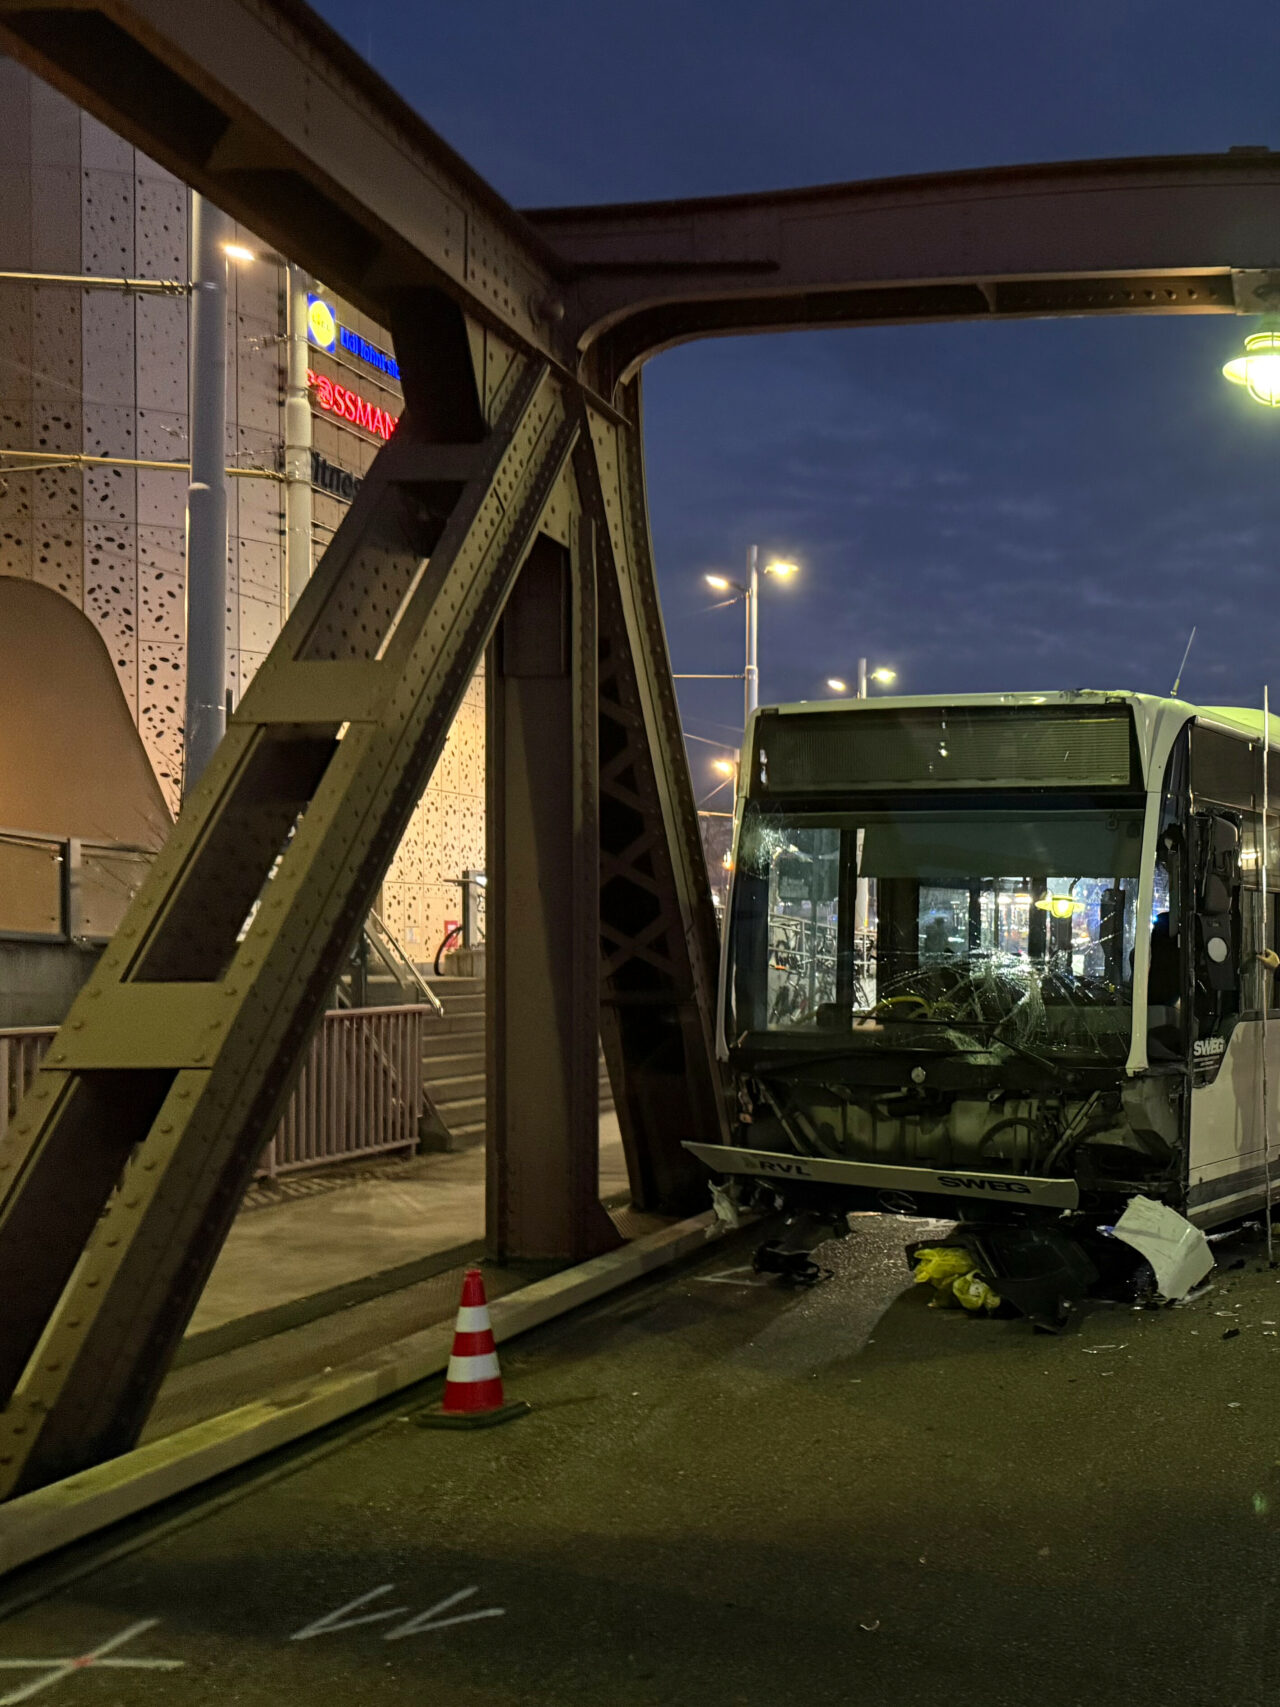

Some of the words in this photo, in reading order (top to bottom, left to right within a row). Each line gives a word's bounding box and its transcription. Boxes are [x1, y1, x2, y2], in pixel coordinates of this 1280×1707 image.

[339, 326, 359, 355] Lidl
[1193, 1038, 1225, 1056] SWEG
[759, 1160, 813, 1176] RVL
[936, 1176, 1031, 1194] SWEG
